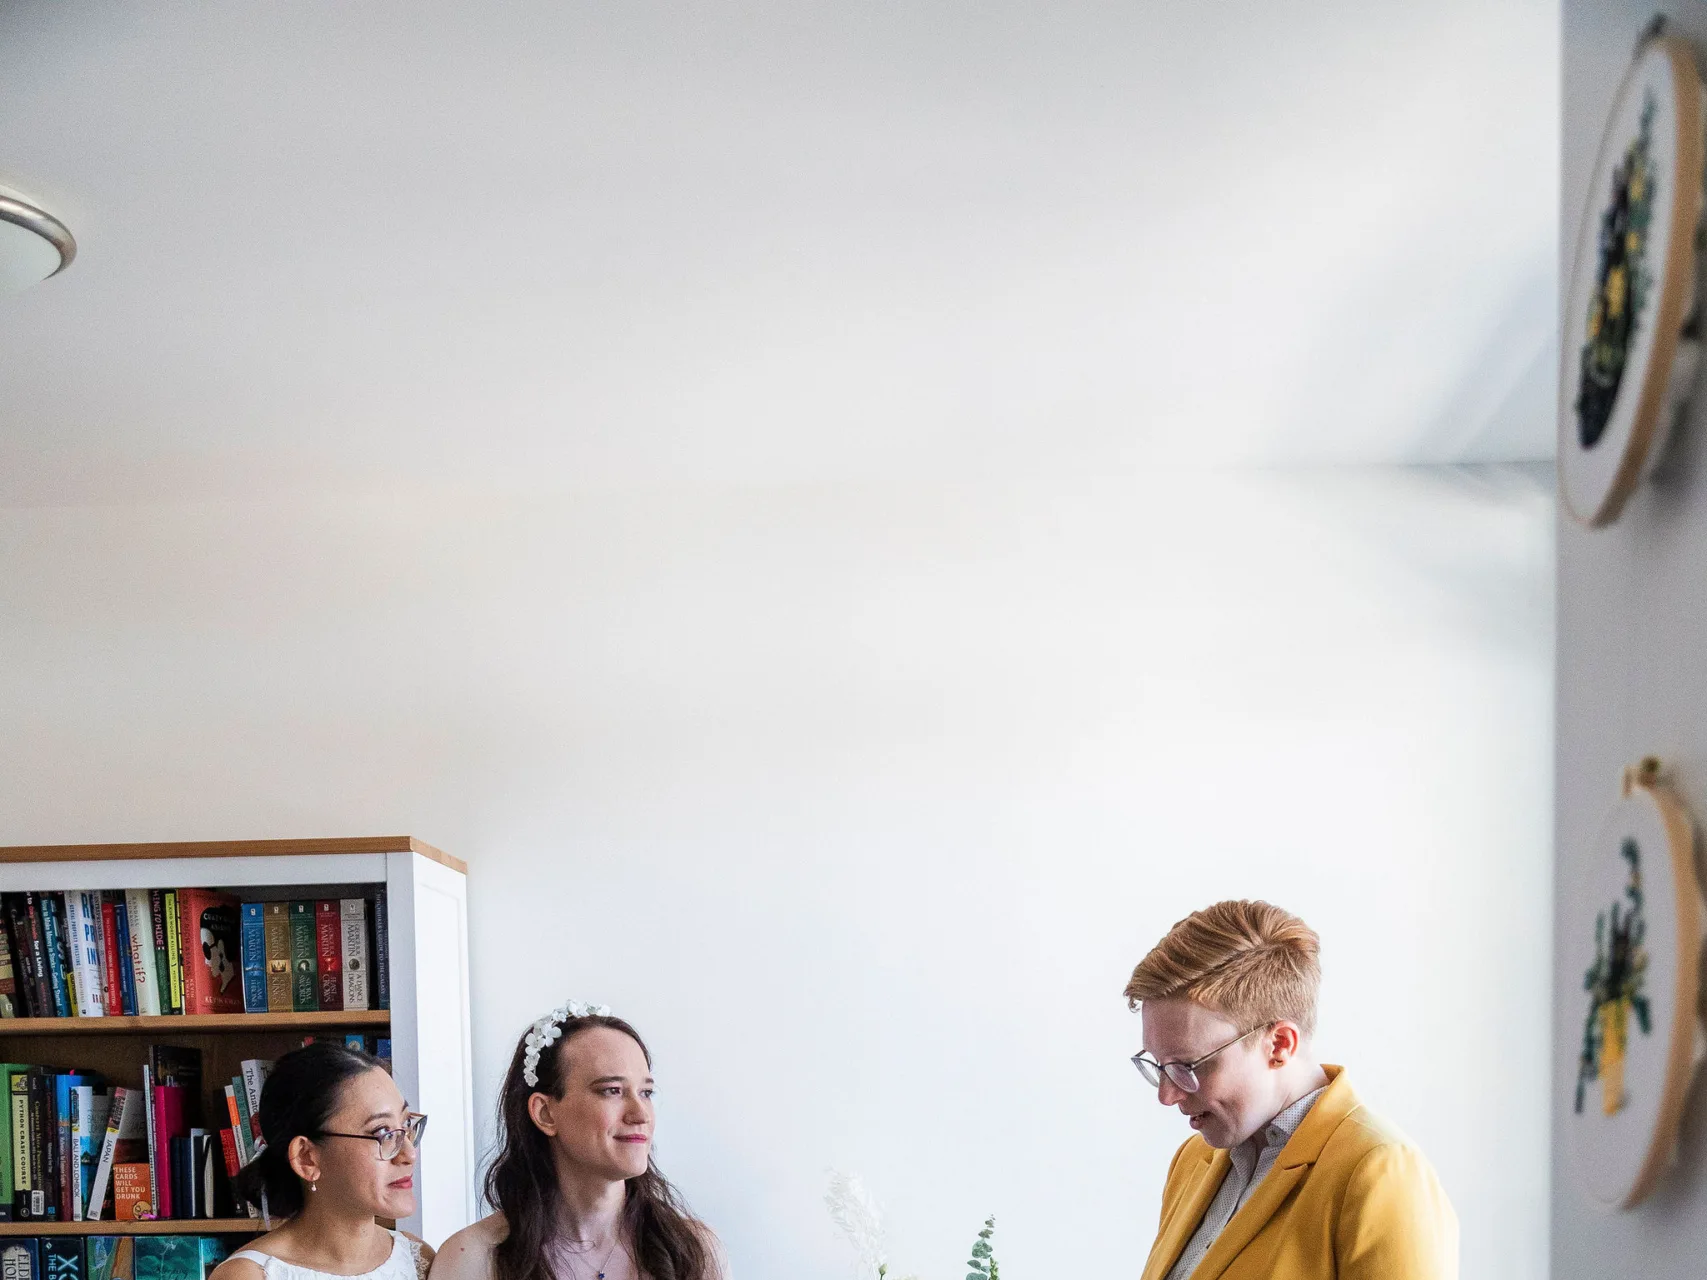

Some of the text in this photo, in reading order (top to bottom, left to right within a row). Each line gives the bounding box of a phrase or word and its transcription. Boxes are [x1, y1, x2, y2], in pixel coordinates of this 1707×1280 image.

[154, 914, 162, 923] TO
[154, 925, 164, 945] HIDE
[248, 928, 257, 961] MARTIN
[271, 927, 280, 959] MARTIN
[296, 926, 305, 958] MARTIN
[321, 924, 330, 957] MARTIN
[348, 924, 357, 957] MARTIN
[132, 934, 146, 983] what if?
[272, 977, 282, 1004] KINGS
[322, 974, 331, 1002] CROWS
[246, 1068, 258, 1113] The Anato
[102, 1139, 113, 1163] JAPAN
[47, 1254, 56, 1272] THE
